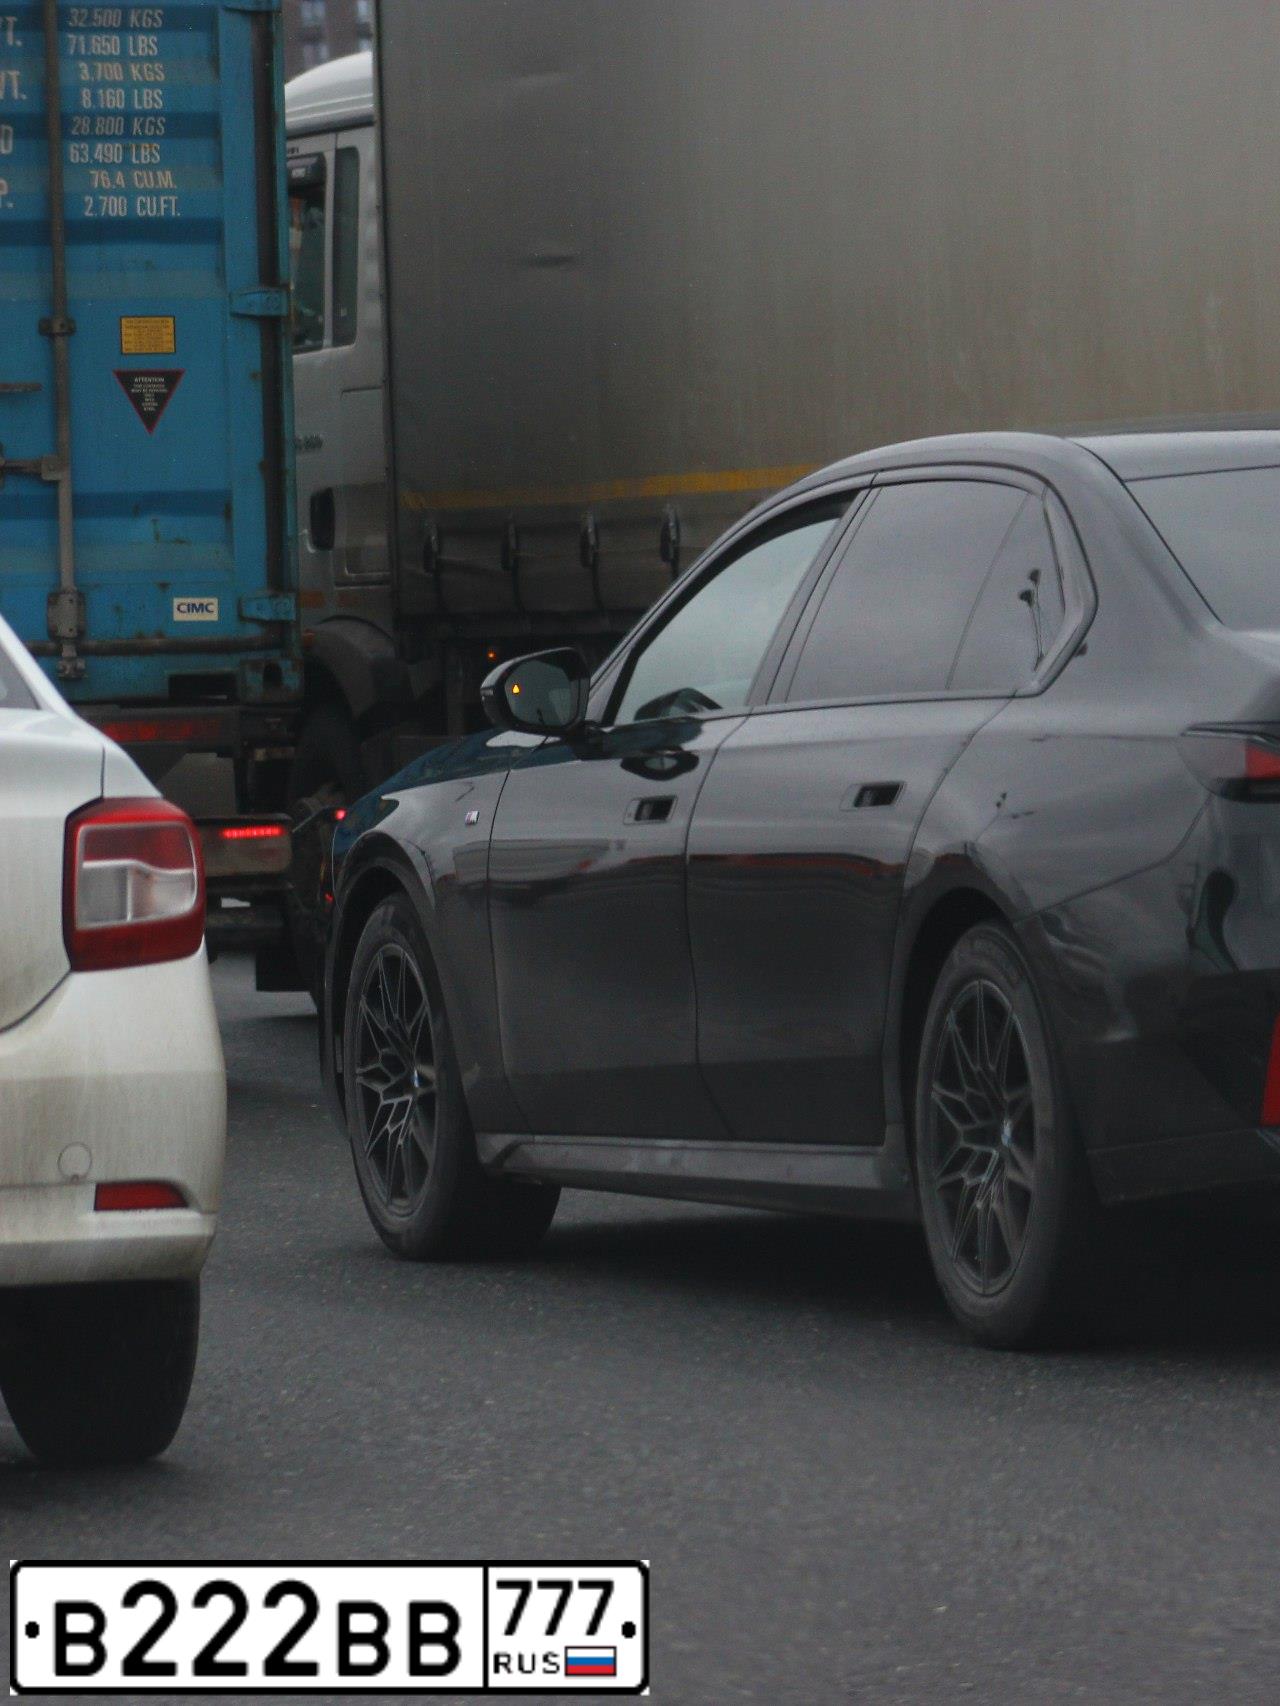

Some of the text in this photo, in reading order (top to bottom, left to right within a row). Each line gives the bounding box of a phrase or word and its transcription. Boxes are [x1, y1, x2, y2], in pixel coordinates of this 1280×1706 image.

[129, 8, 164, 28] KGS
[128, 35, 158, 56] LBS
[79, 62, 166, 82] 3.700 KGS
[81, 87, 163, 109] 8.160 LBS
[132, 116, 166, 135] KGS
[69, 142, 160, 164] 63.490 LBS
[90, 170, 125, 188] 76.4
[84, 196, 127, 216] 2.700
[176, 602, 214, 613] CIMC
